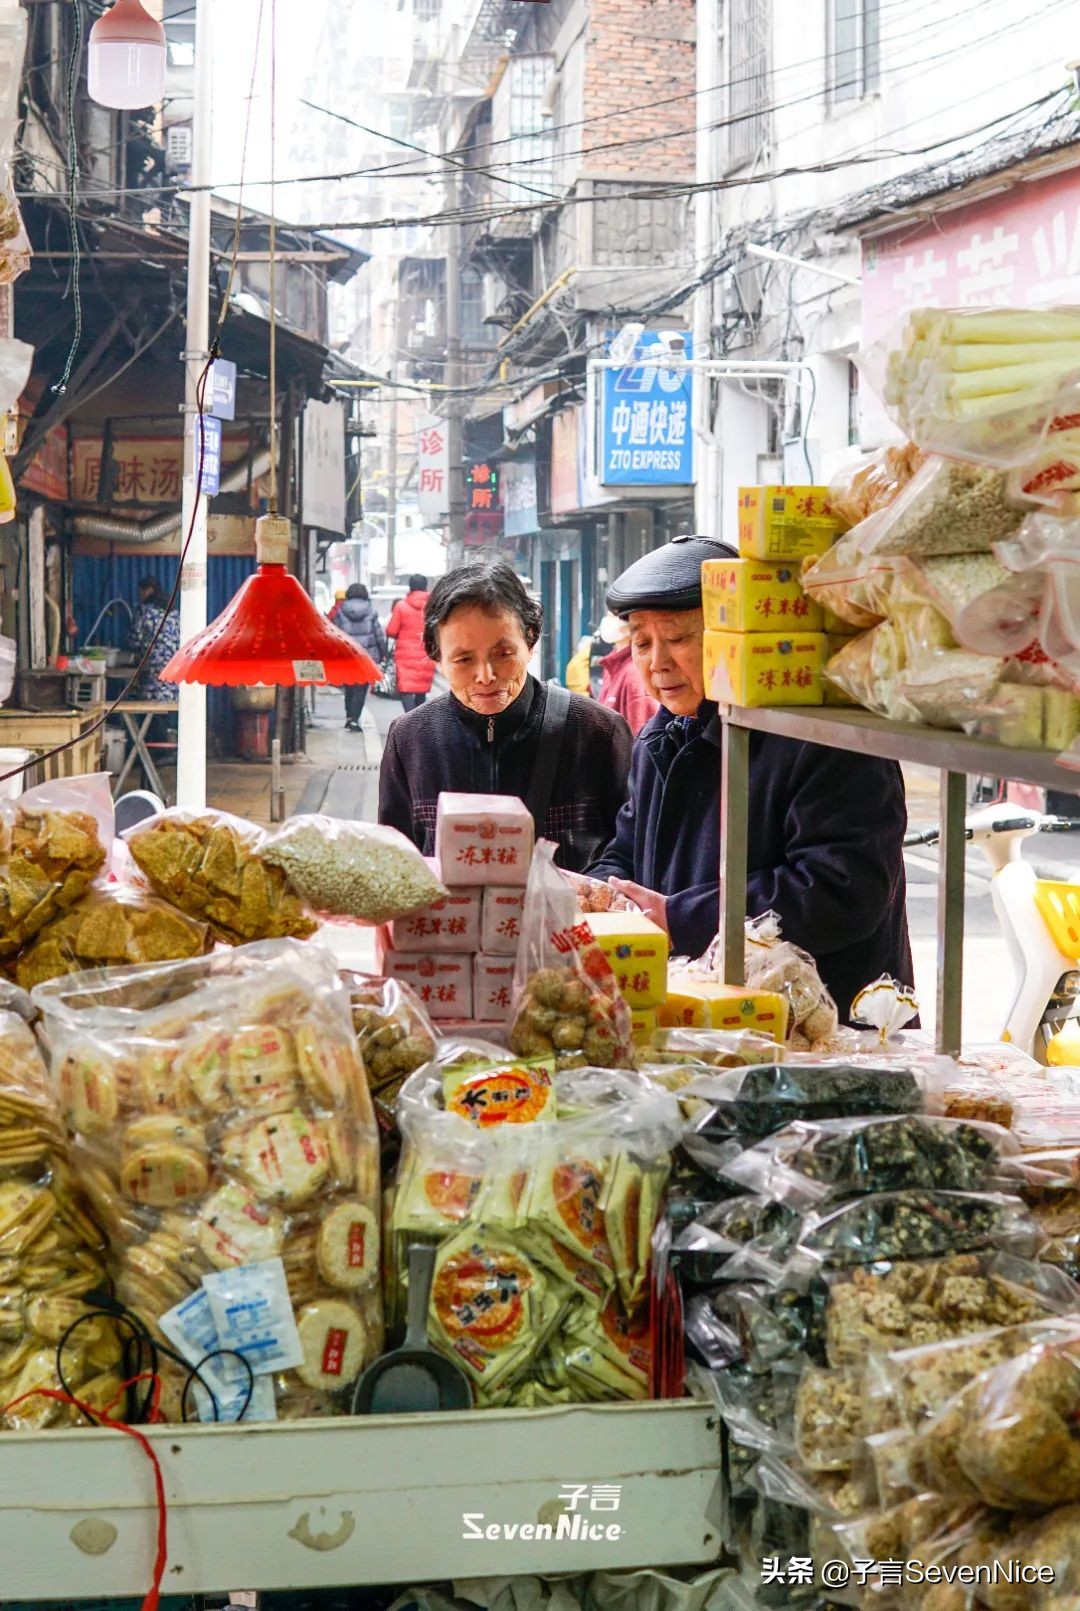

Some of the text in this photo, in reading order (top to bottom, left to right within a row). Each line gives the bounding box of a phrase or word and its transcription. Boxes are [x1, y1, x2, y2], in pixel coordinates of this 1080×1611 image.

[611, 400, 687, 446] 中通快递
[420, 430, 445, 493] 诊所
[608, 449, 681, 470] ZTO EXPRESS
